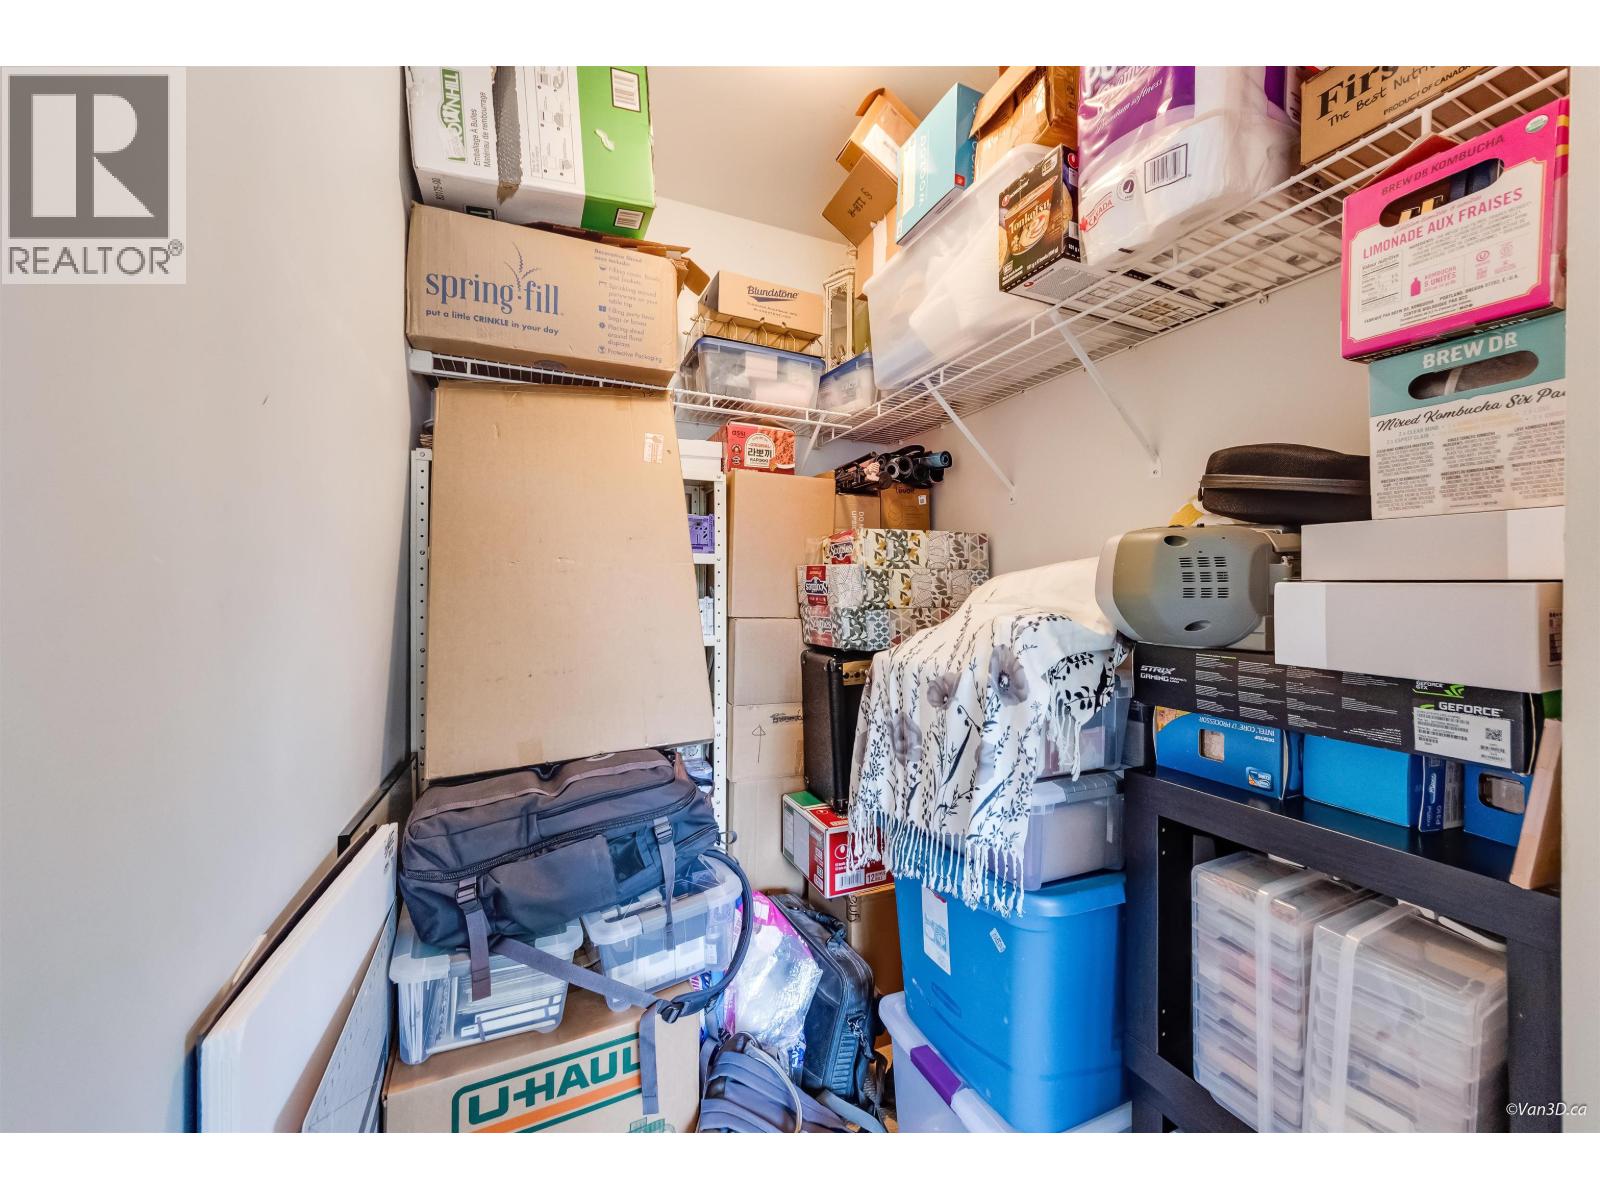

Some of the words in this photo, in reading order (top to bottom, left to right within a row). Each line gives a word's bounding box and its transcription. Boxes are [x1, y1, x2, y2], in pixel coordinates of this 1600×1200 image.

[480, 92, 490, 131] rembourrage
[1327, 110, 1350, 128] The
[1356, 86, 1388, 112] Best
[1383, 91, 1421, 115] PRODUCT
[1422, 83, 1435, 95] OF
[482, 132, 490, 140] de
[1381, 175, 1413, 196] BREW
[1431, 134, 1506, 174] KOMBUCHA
[1008, 199, 1052, 232] Tonkotsu
[1088, 199, 1113, 226] CANADA
[1362, 226, 1423, 259] LIMONADE
[1427, 215, 1454, 235] AUX
[1458, 187, 1524, 224] FRAISES
[746, 284, 798, 299] Blundstone
[425, 309, 441, 317] put
[451, 311, 471, 321] little
[473, 314, 509, 327] CRINKLE
[511, 320, 519, 328] in
[522, 324, 540, 334] your
[543, 325, 560, 336] day
[1423, 340, 1484, 369] BREW
[1377, 417, 1420, 433] Mixed
[1423, 402, 1502, 423] Kombucha
[1506, 393, 1533, 408] Six
[1140, 664, 1176, 675] STRIX
[1140, 672, 1170, 683] GAMING
[1415, 680, 1444, 688] GEFORCE
[1198, 716, 1231, 729] PROCESSOR
[1438, 701, 1501, 717] GEFORCE
[1238, 724, 1256, 733] CORE
[1256, 727, 1276, 736] INTEL
[867, 873, 875, 883] 12
[468, 1046, 641, 1126] U-HAUL
